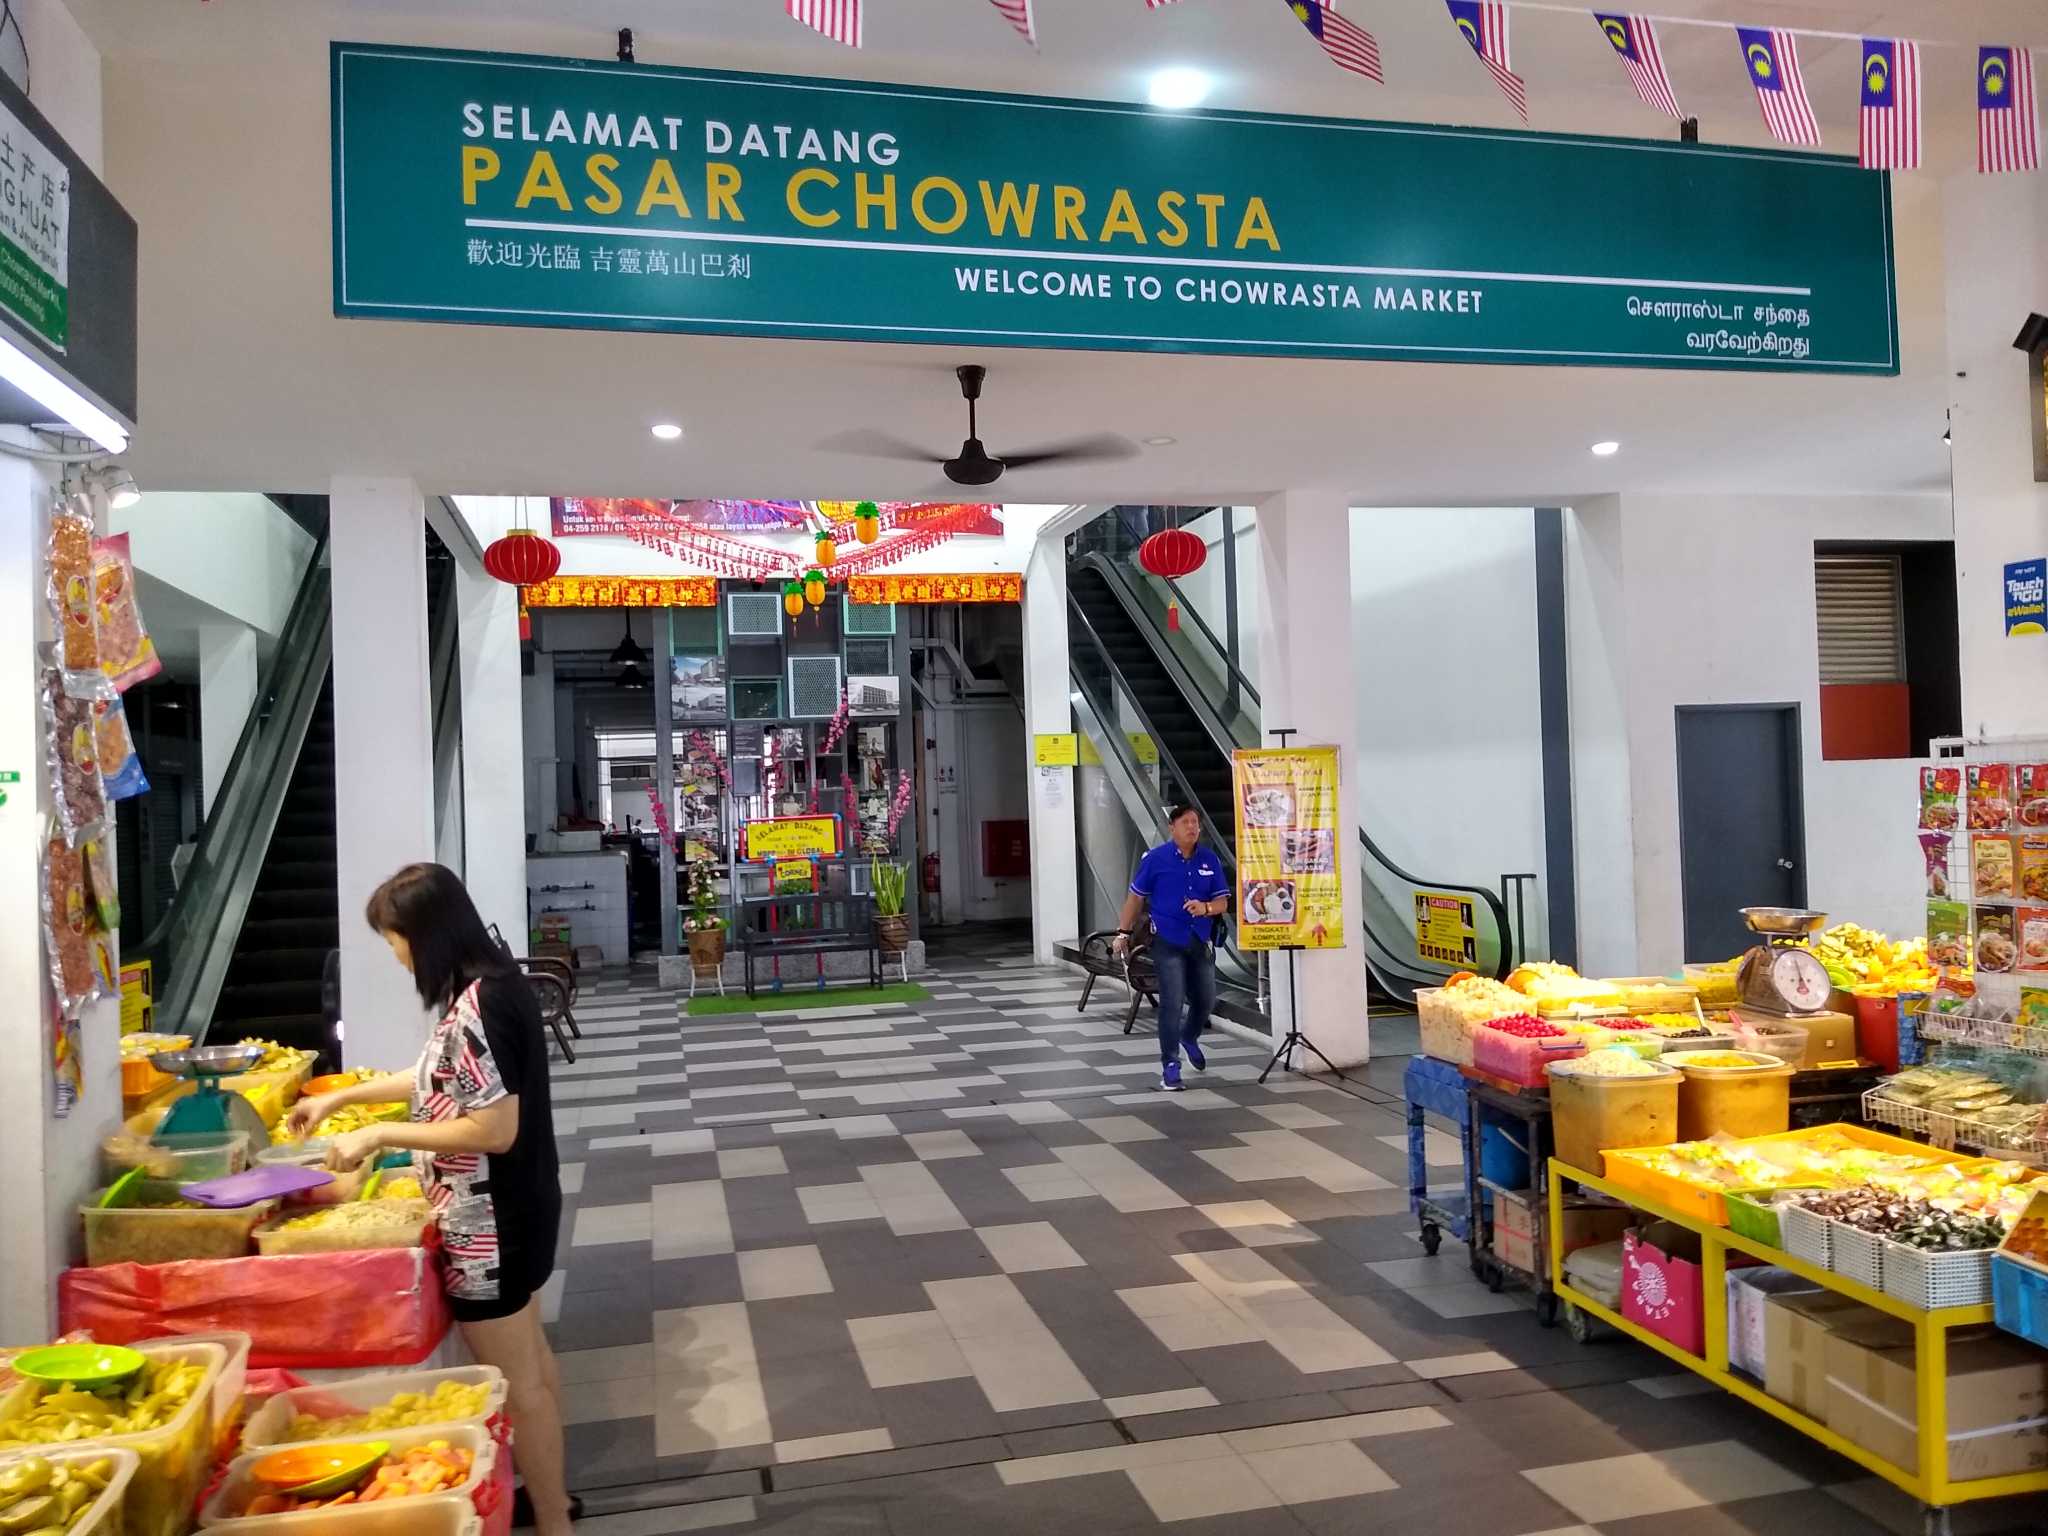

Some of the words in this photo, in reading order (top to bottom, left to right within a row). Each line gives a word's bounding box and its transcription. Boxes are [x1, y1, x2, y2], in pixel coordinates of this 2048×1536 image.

[462, 102, 683, 152] SELAMAT
[705, 120, 901, 166] DATANG
[462, 146, 742, 221] PASAR
[786, 168, 1281, 252] CHOWRASTA
[466, 238, 581, 270] 歡迎光臨
[954, 267, 1112, 298] WELCOME
[1123, 275, 1162, 301] TO
[1175, 277, 1361, 309] CHOWRASTA
[1373, 286, 1483, 314] MARKET
[1753, 304, 1811, 329] சந்தை
[1686, 329, 1811, 359] வரவேற்கிறது
[2006, 576, 2044, 593] Touch
